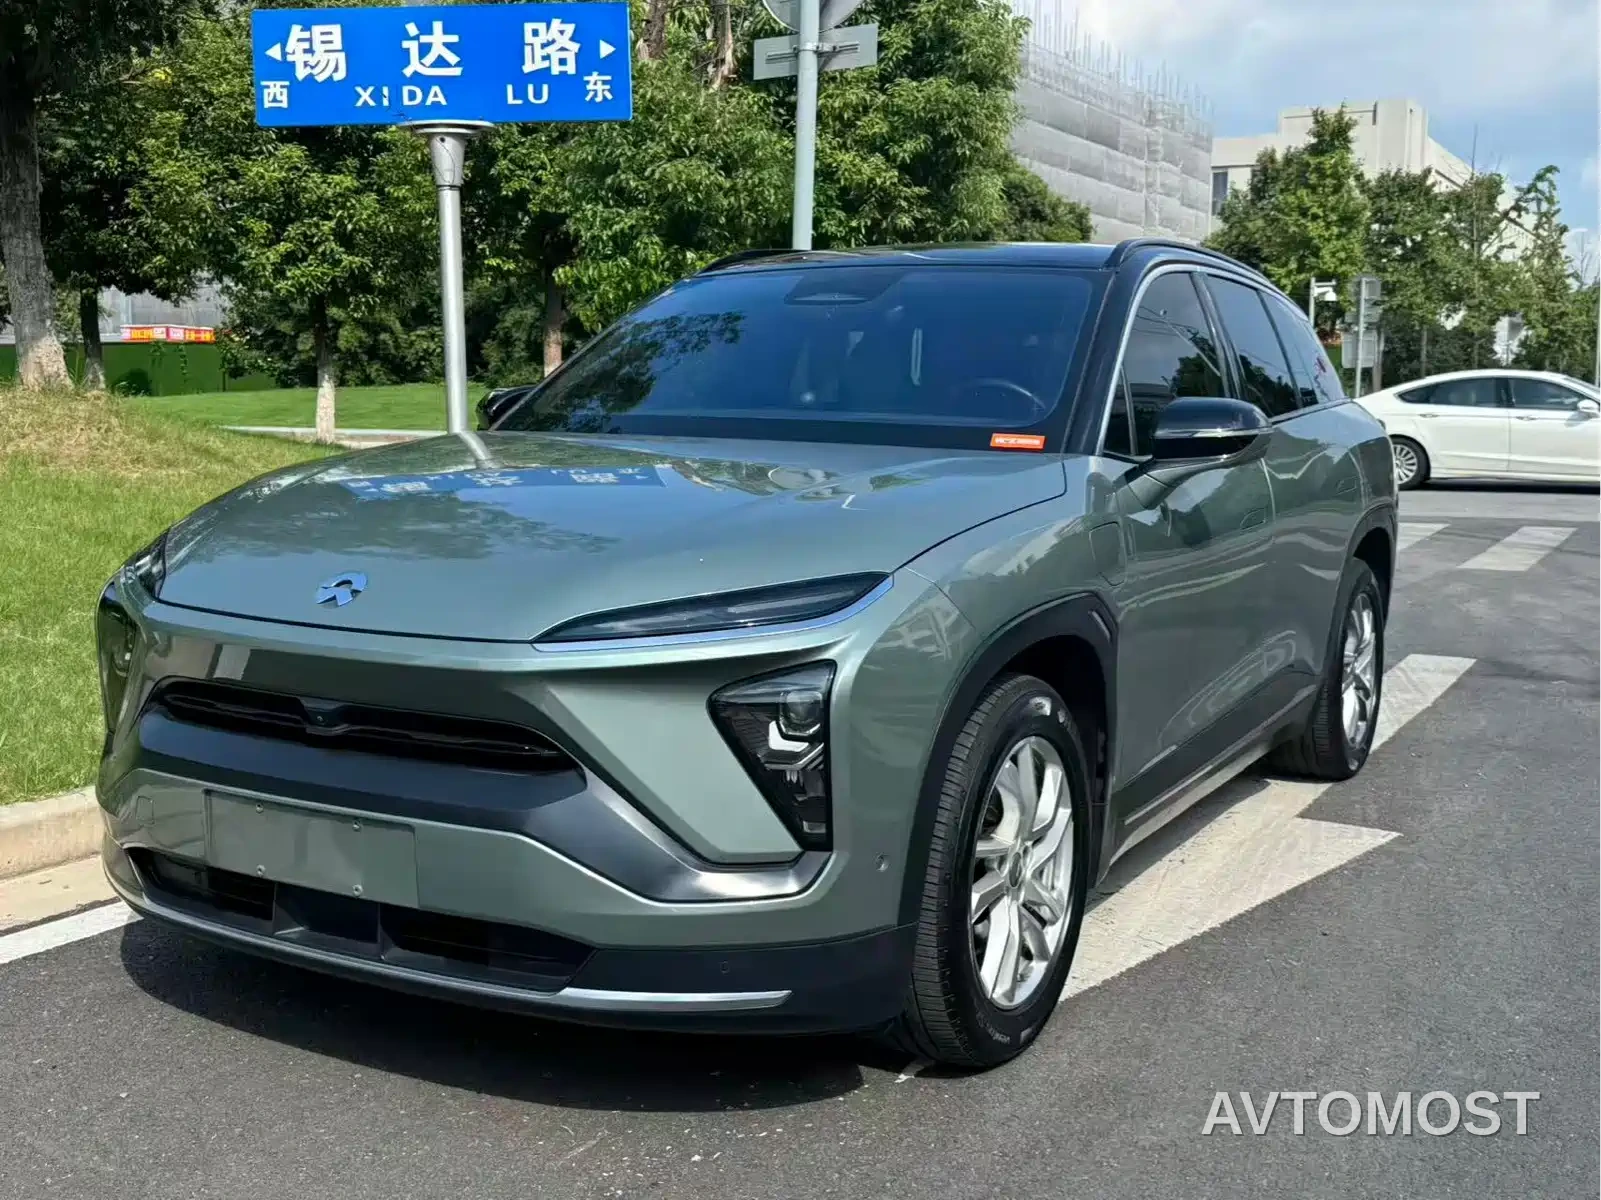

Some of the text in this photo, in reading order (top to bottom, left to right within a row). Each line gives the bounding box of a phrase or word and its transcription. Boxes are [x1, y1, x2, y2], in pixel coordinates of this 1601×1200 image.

[285, 18, 581, 84] 锡达路
[261, 80, 290, 109] 西
[506, 84, 550, 105] LU
[584, 71, 613, 103] 东
